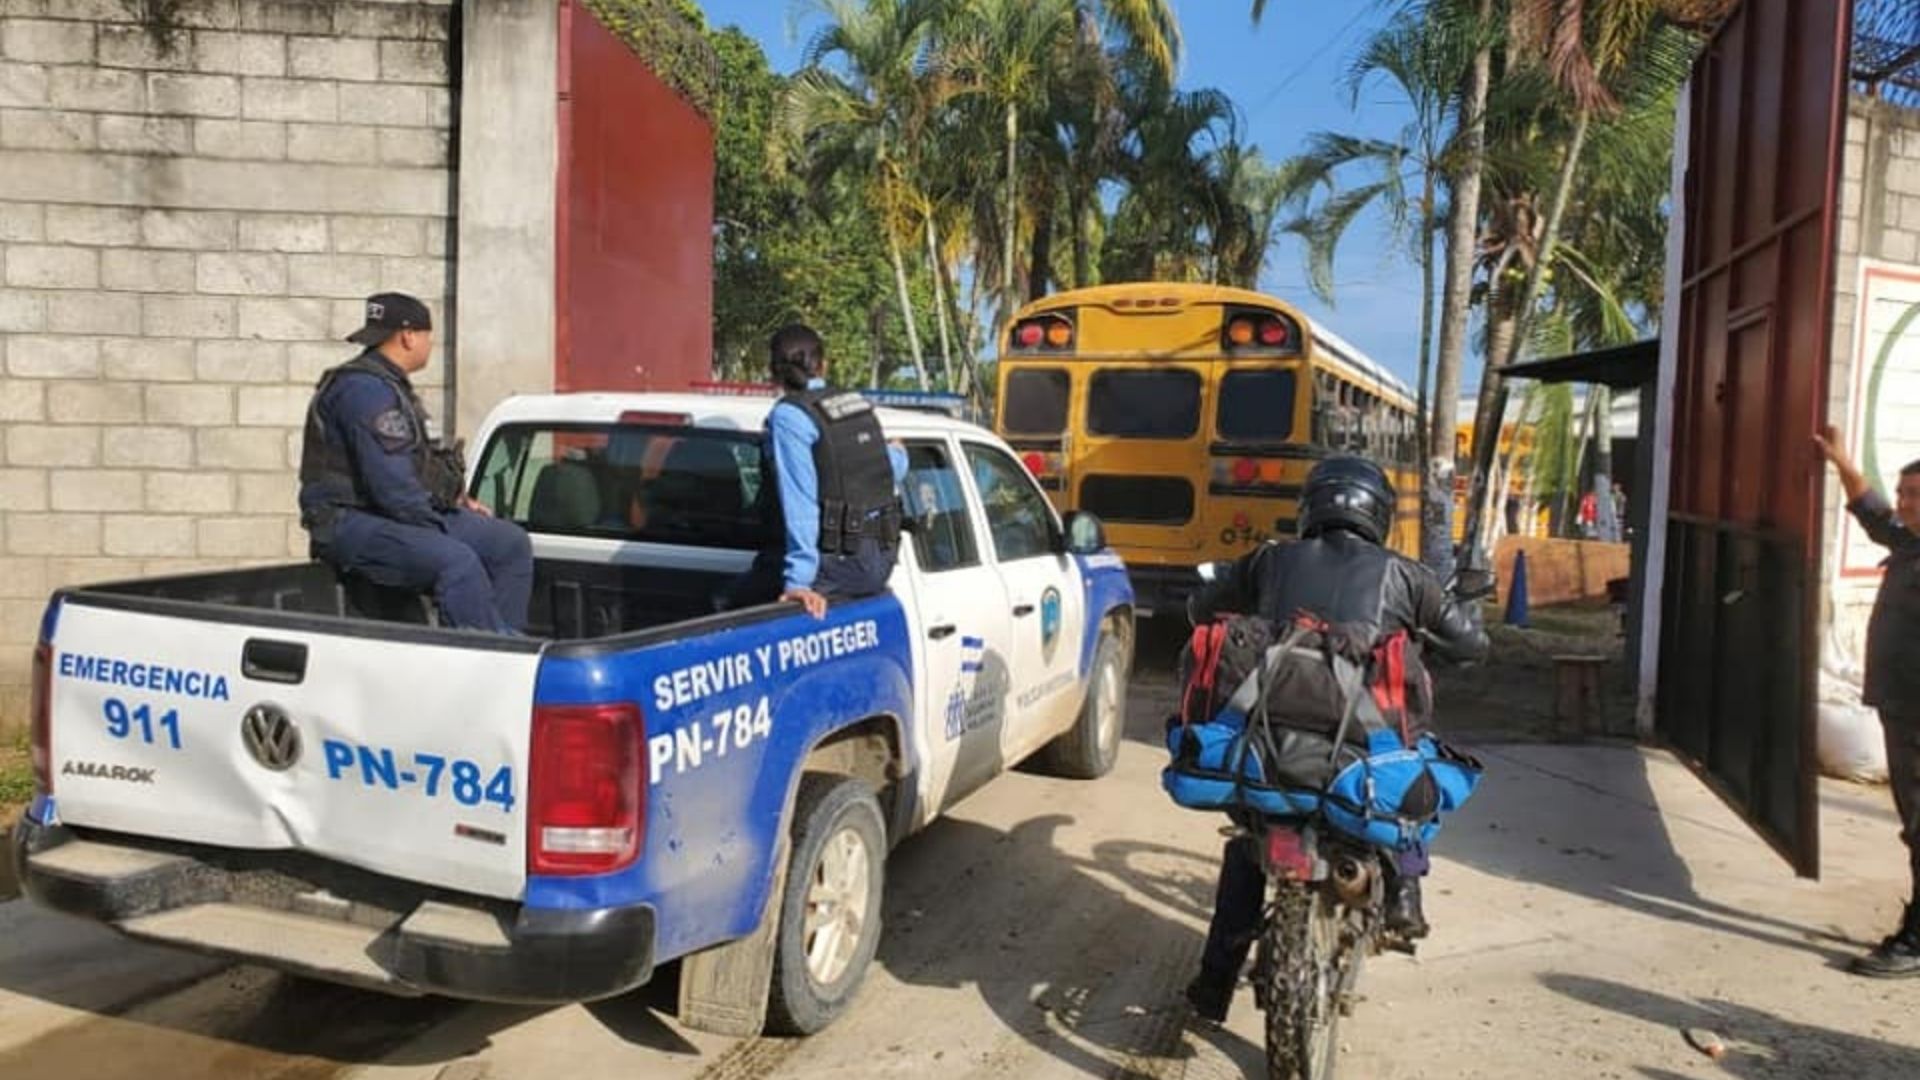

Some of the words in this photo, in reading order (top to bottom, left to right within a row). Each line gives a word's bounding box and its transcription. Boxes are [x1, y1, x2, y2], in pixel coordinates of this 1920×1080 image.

[59, 653, 229, 701] EMERGENCIA
[654, 653, 753, 710] SERVIR
[756, 644, 772, 678] Y
[778, 620, 879, 671] PROTEGER
[104, 698, 182, 748] 911
[649, 696, 772, 784] PN-784
[61, 759, 157, 784] AMAROK
[322, 739, 515, 812] PN-784
